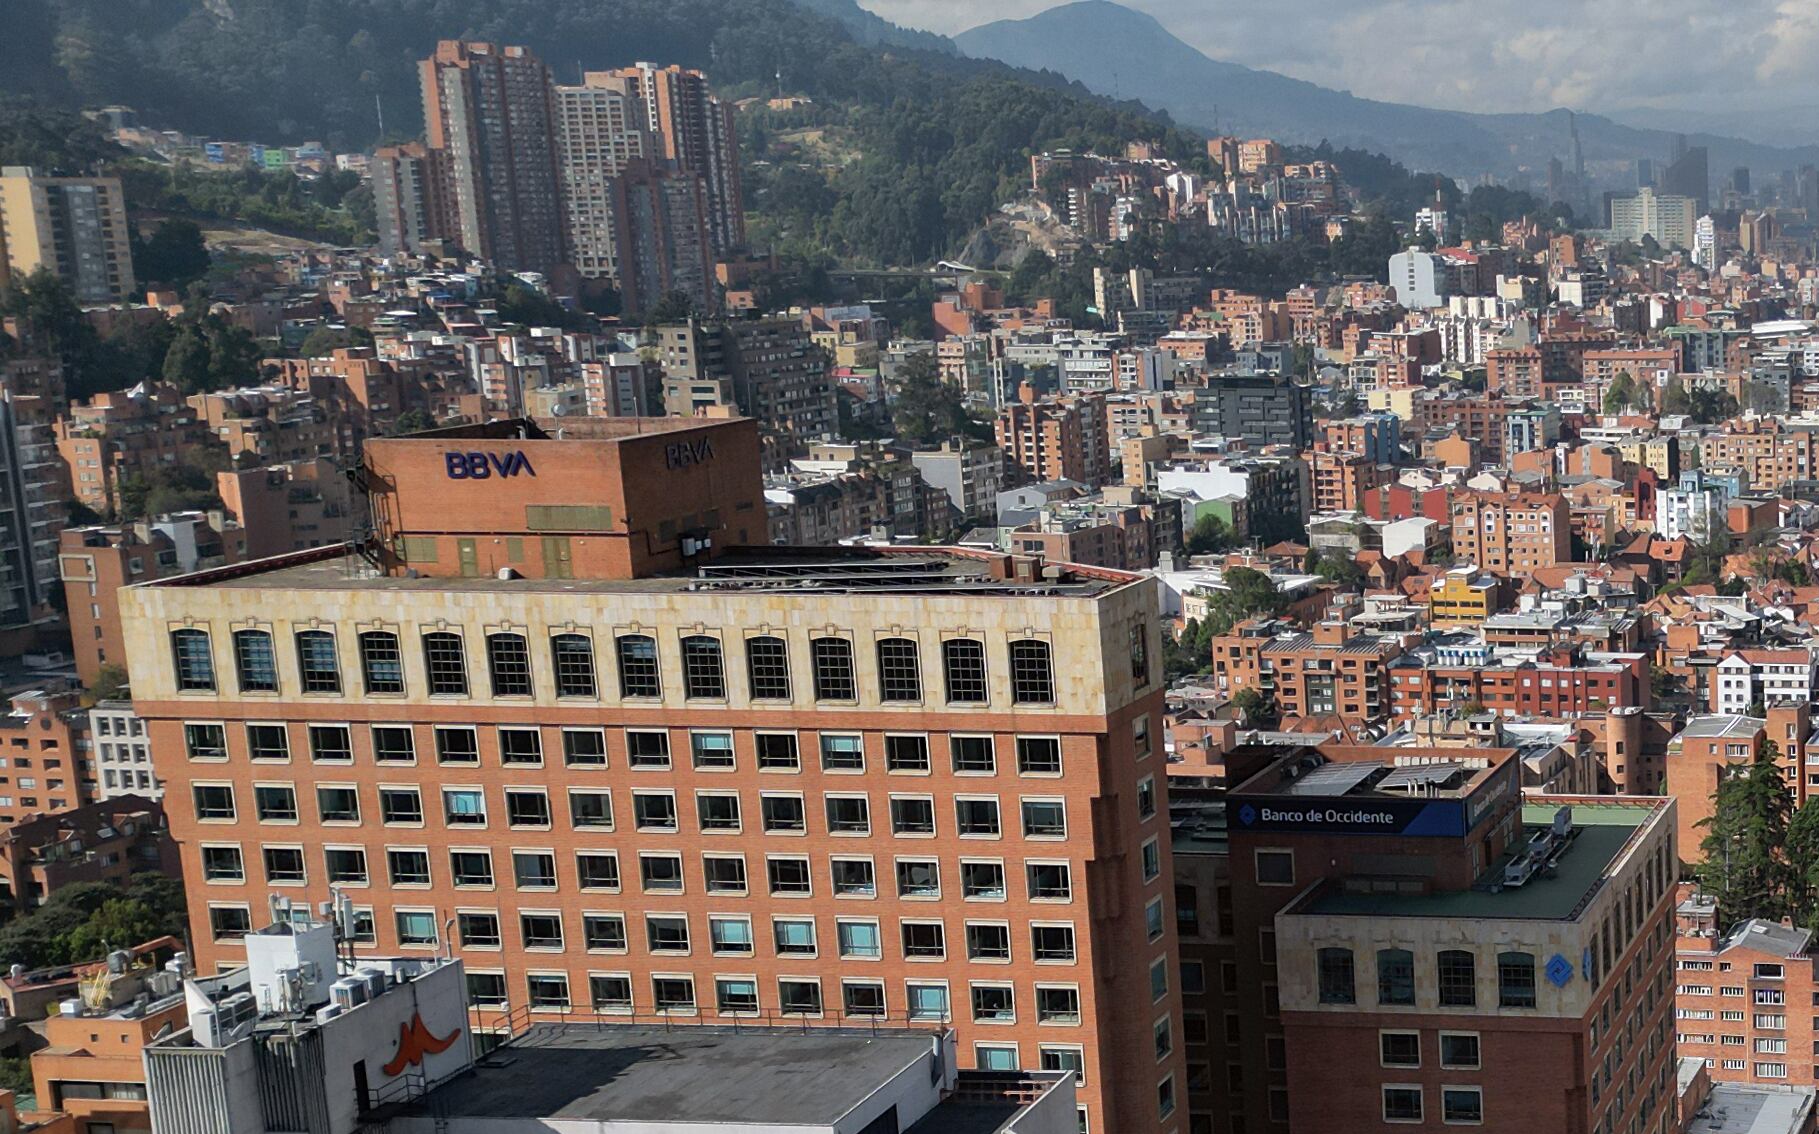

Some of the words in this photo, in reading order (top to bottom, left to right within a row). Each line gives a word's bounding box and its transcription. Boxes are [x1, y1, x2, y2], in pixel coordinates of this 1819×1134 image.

[445, 450, 536, 479] BBVA
[664, 435, 715, 469] BBVA
[1261, 808, 1304, 822] Banco
[1306, 809, 1323, 823] de
[1325, 809, 1394, 825] Occidente
